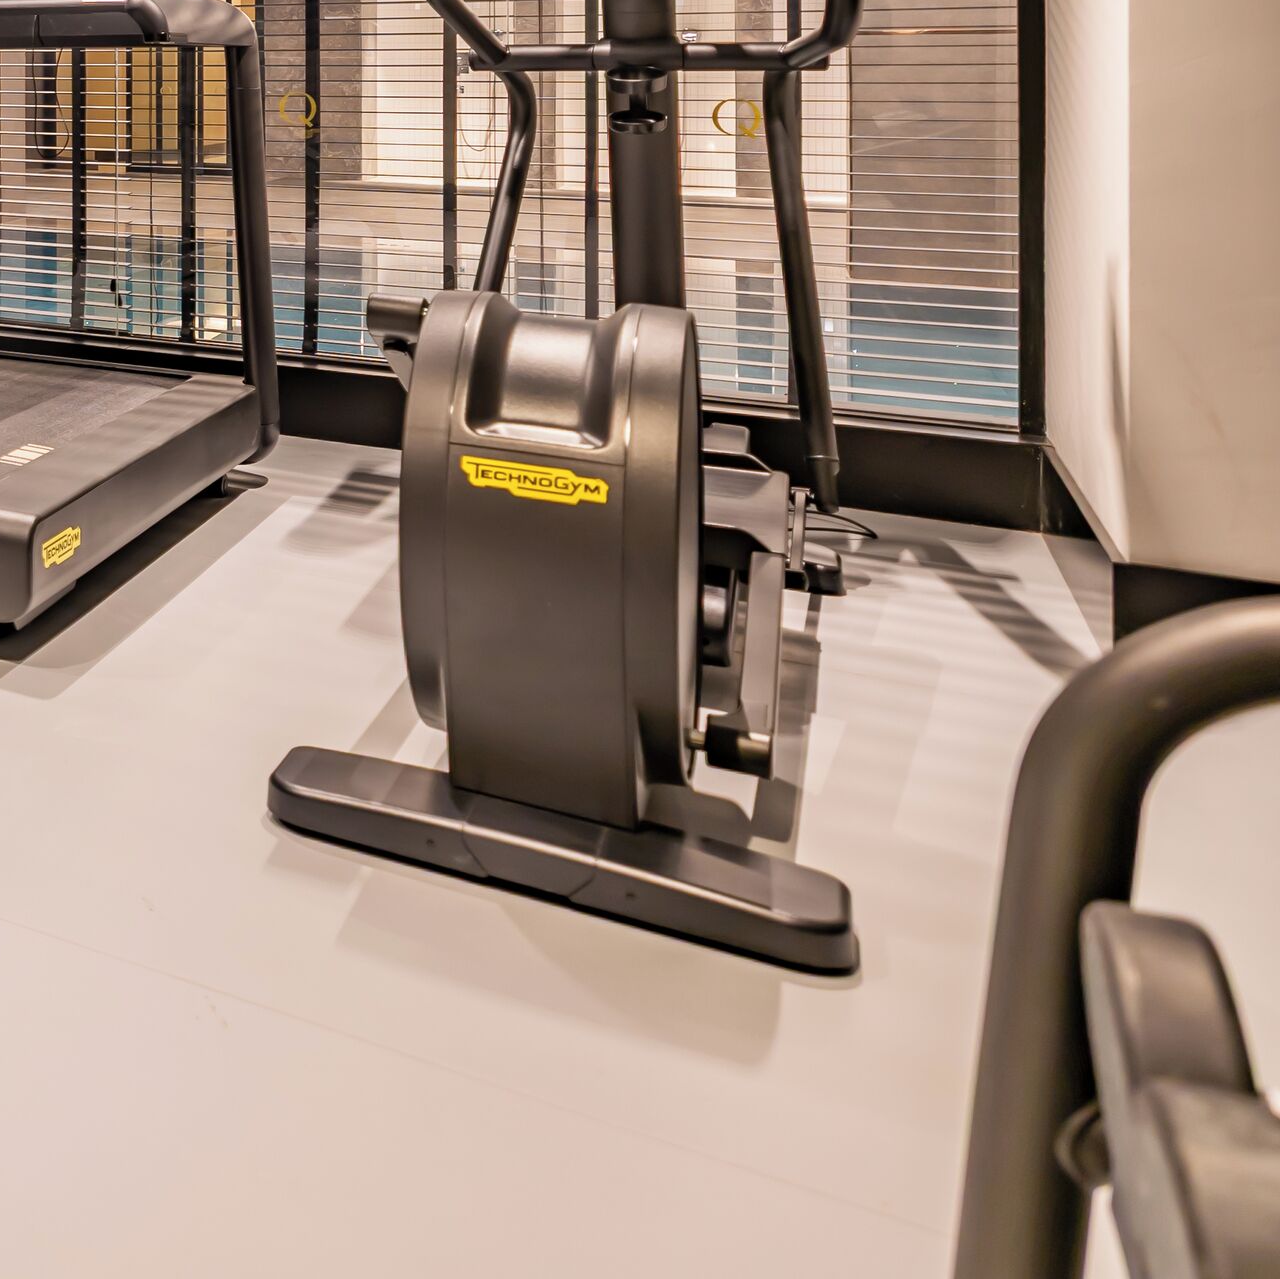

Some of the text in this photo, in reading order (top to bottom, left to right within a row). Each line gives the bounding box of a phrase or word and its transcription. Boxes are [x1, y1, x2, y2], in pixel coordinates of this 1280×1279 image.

[279, 91, 317, 127] Q
[712, 99, 760, 139] Q
[466, 461, 601, 496] TECHNOGYM
